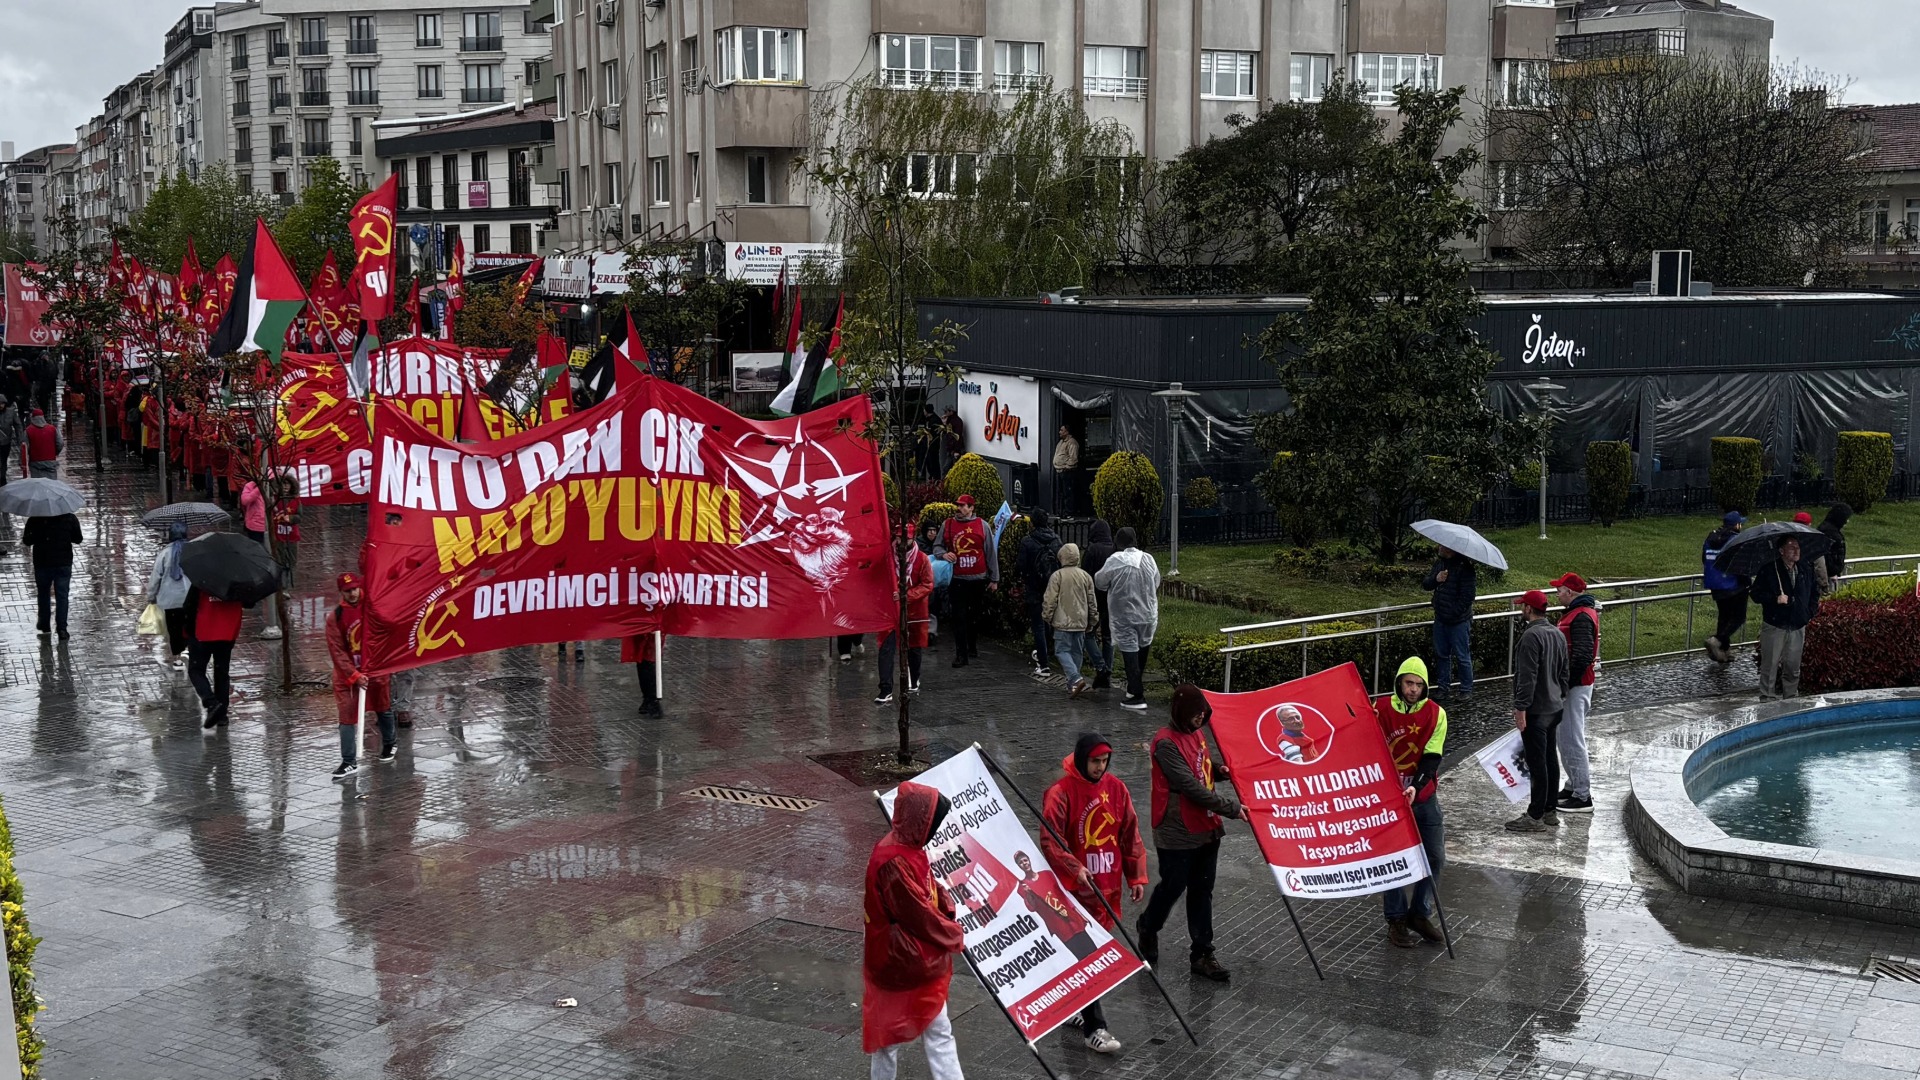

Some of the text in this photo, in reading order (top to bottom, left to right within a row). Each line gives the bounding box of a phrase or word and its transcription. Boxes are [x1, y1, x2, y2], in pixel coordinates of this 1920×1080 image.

[1523, 313, 1574, 368] İçten
[378, 408, 706, 511] NATO'DAN ÇIK
[432, 477, 742, 574] NATO'YU YIK!
[473, 567, 619, 620] DEVRİMCİ
[951, 777, 989, 809] emekçi
[1253, 762, 1385, 800] ATLEN YILDIRIM
[960, 797, 1003, 832] Alyakut
[1268, 808, 1398, 840] Devrimi Kavgasında
[1271, 793, 1381, 820] Sosyalist Dünya
[930, 844, 972, 880] syalist
[1086, 848, 1115, 875] DİP
[1298, 836, 1373, 863] Yaşayacak
[1301, 870, 1345, 886] DEVRİMCİ
[1344, 866, 1366, 883] İŞÇİ
[1366, 857, 1409, 879] PARTİSİ
[957, 899, 997, 935] evrimi
[969, 914, 1039, 964] kavgasında
[986, 935, 1057, 995] yaşayacak!
[1026, 947, 1122, 1016] DEVRİMCİ İŞÇİ PARTİSİ
